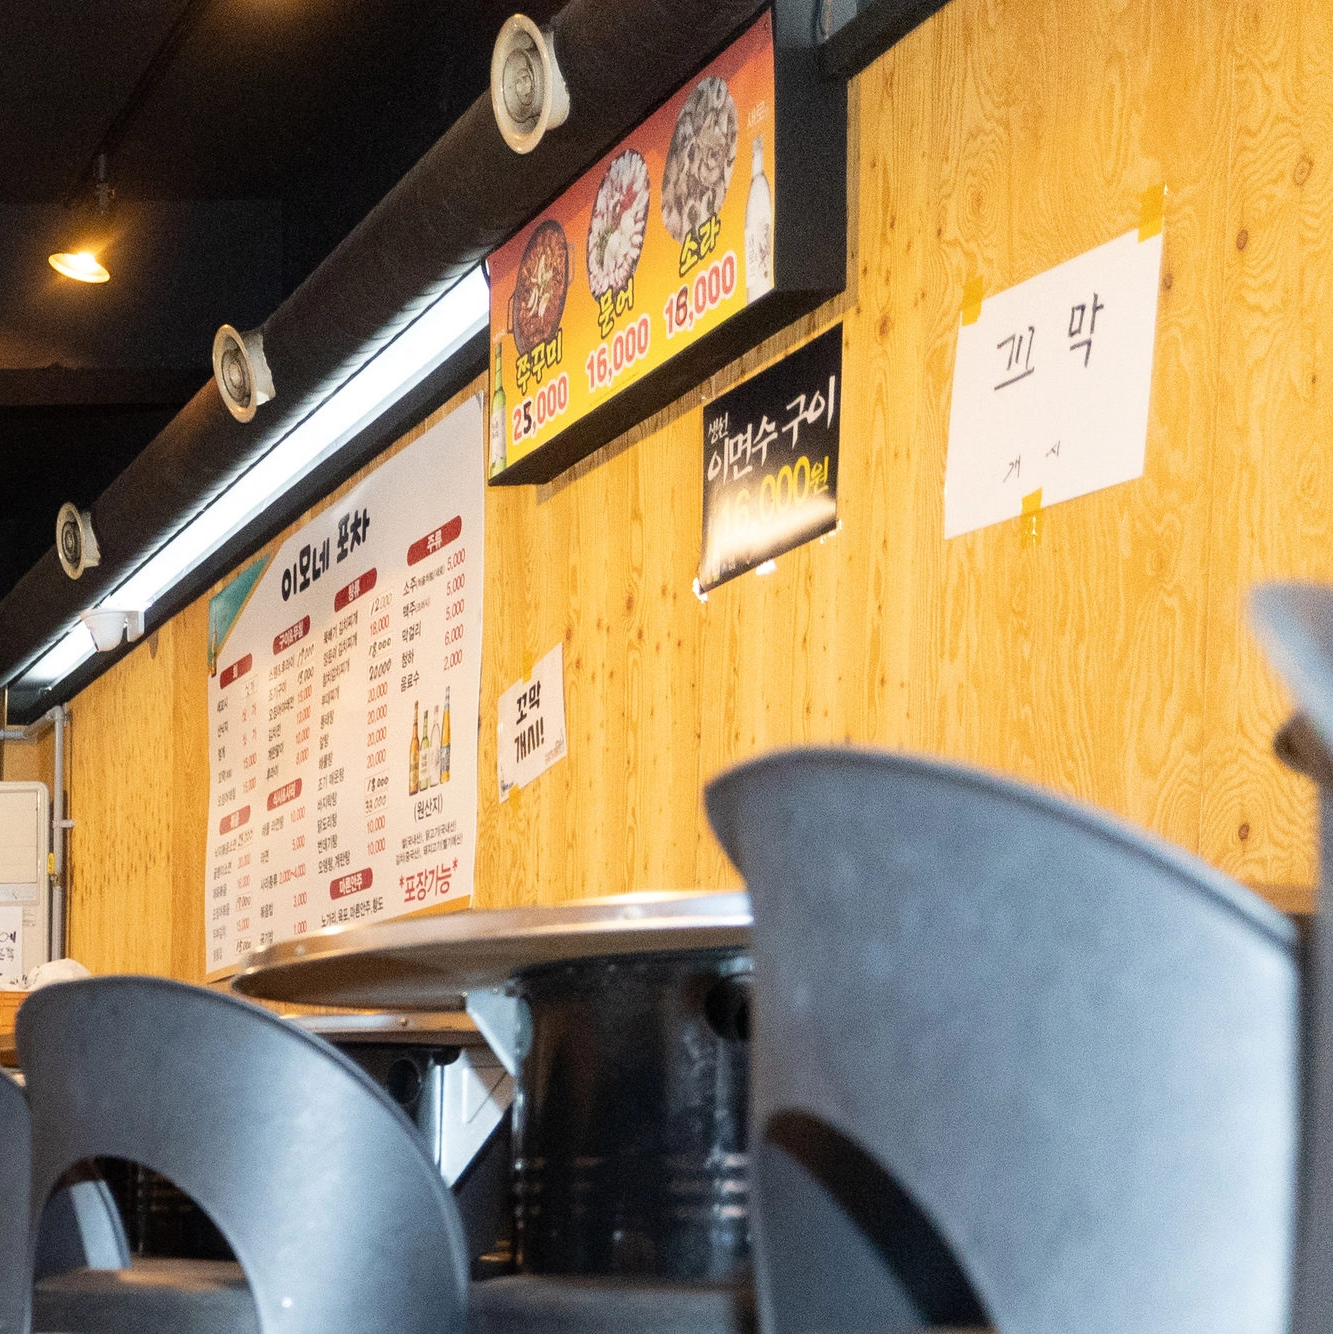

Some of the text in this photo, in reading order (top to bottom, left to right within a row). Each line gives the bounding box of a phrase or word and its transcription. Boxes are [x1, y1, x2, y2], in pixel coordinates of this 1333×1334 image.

[597, 278, 634, 340] 문어
[678, 214, 721, 278] 소라
[513, 375, 568, 442] 25,000
[586, 317, 649, 391] 16,000
[664, 254, 735, 335] 18,000
[707, 375, 836, 484] 이면수 구이
[708, 412, 728, 444] 생선
[426, 529, 443, 553] 주류
[281, 508, 370, 602] 이모네 포차
[447, 548, 465, 571] 5,000
[348, 578, 360, 601] 탕류
[446, 573, 465, 596] 5,000
[369, 614, 390, 637] 18,000
[401, 599, 464, 643] 막걸리 5,000
[401, 623, 464, 669] 청하 6,000
[401, 649, 463, 693] 음료수 2,000
[367, 681, 388, 704] 20,000
[516, 680, 541, 725] 꼬막
[367, 703, 388, 725] 20,000
[367, 726, 387, 747] 20,000
[367, 748, 387, 769] 20,000
[367, 815, 386, 834] 10,000
[367, 837, 386, 856] 10,000
